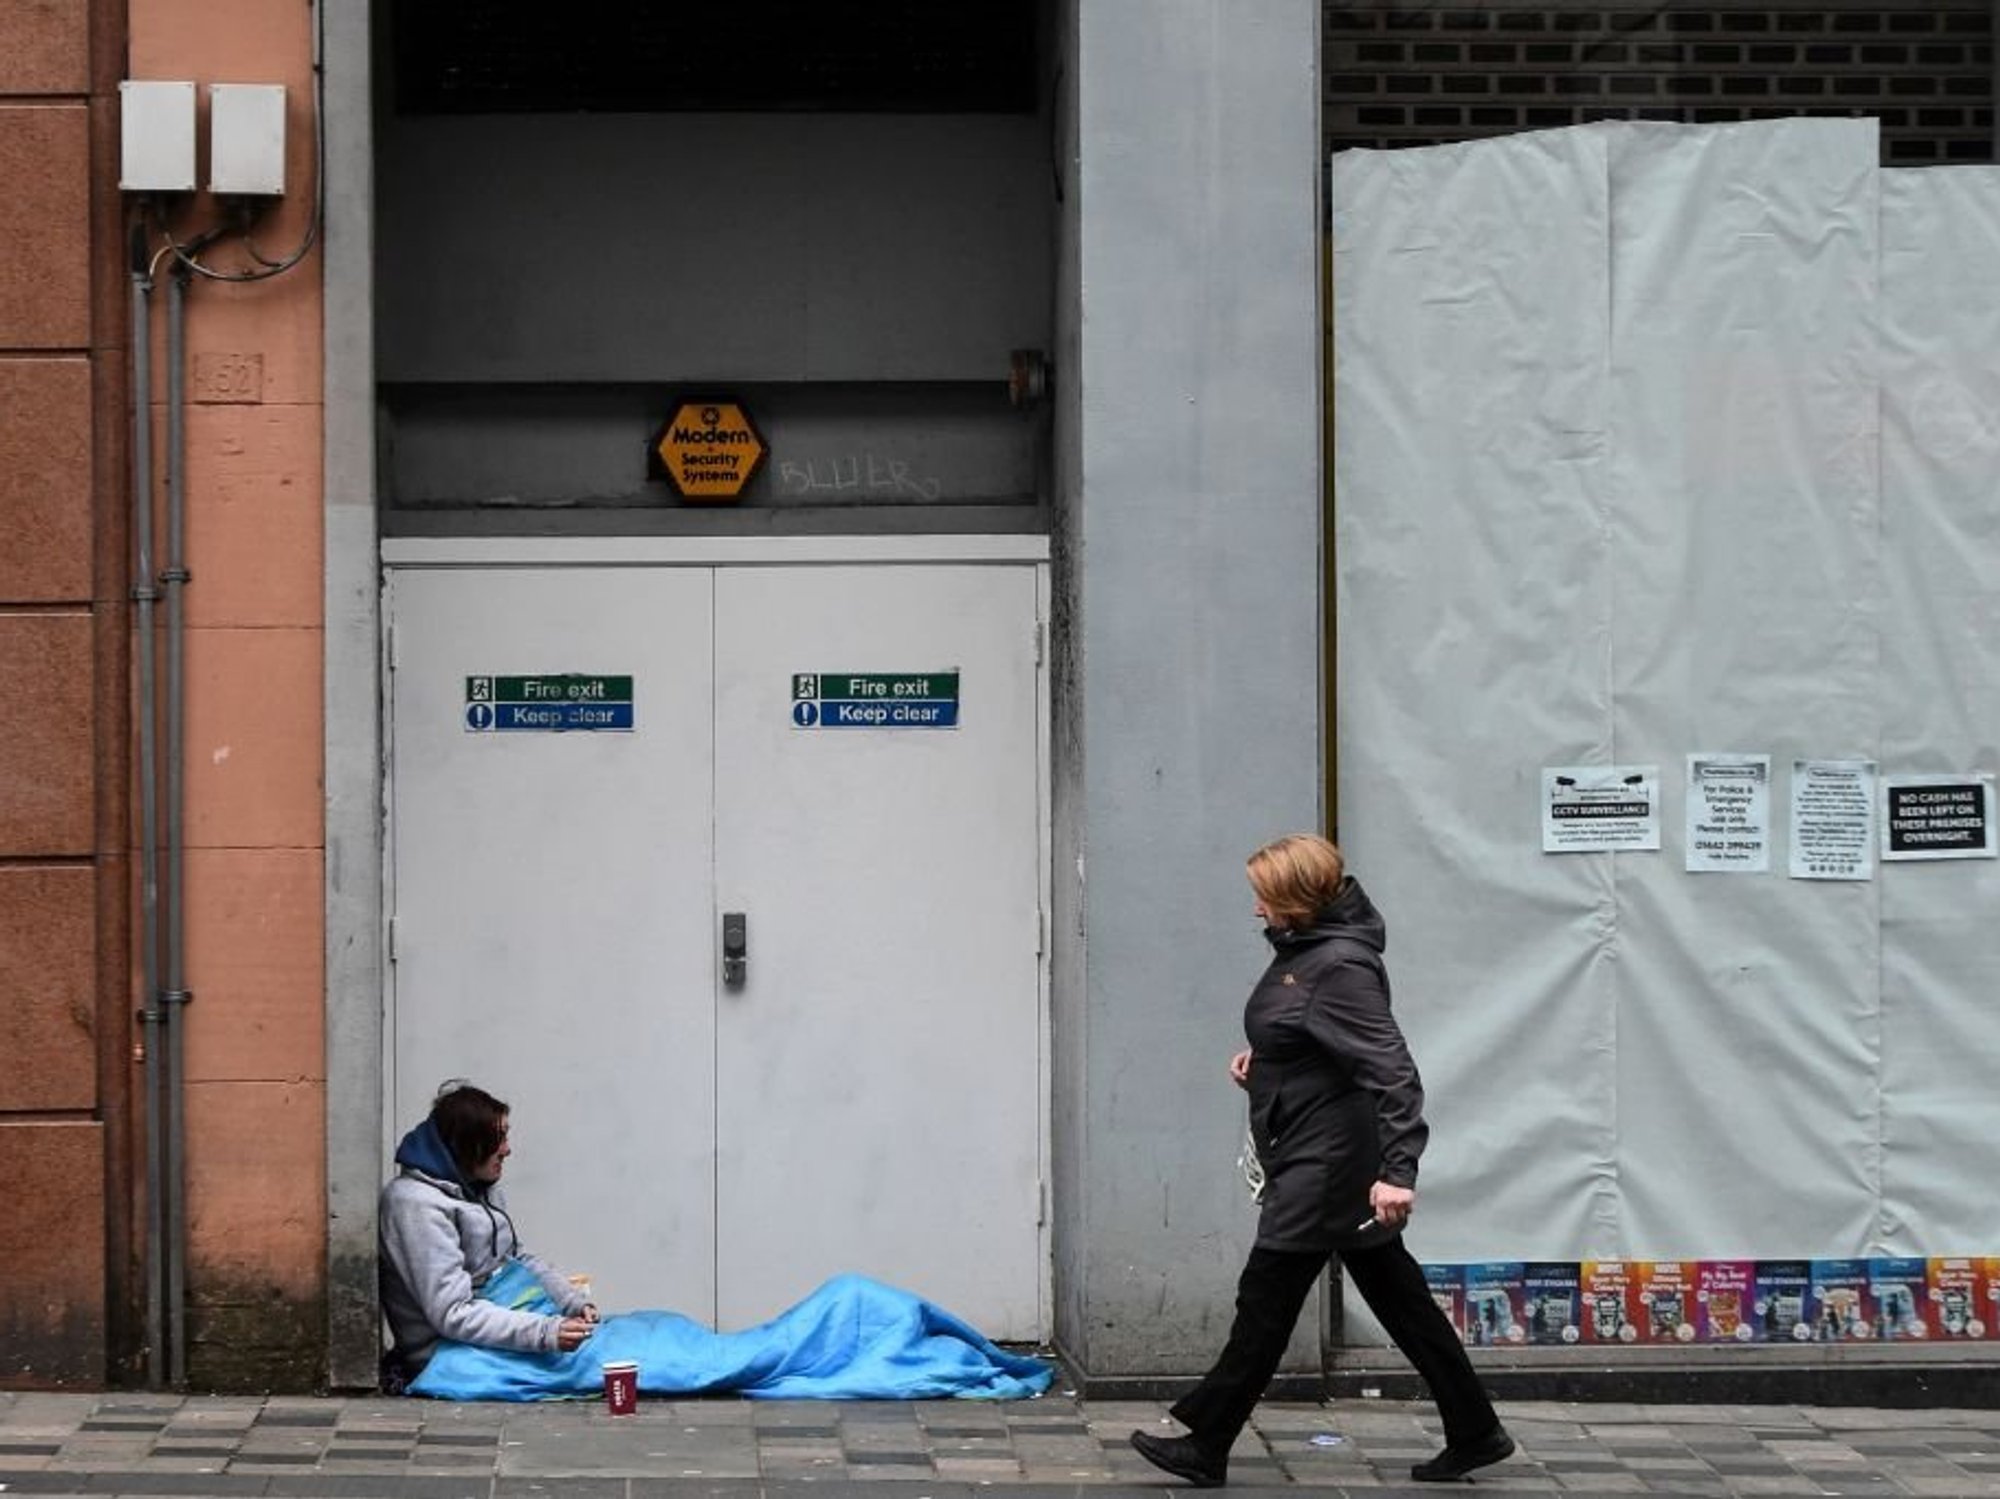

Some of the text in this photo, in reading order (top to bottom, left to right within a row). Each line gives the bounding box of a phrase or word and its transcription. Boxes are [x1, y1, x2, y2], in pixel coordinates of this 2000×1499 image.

[673, 427, 750, 444] Modern
[681, 452, 740, 468] Security
[683, 468, 740, 484] Systems
[524, 681, 605, 698] Fire exit
[849, 679, 929, 695] Fire exit
[513, 706, 615, 726] Keep clear
[838, 705, 939, 724] Keep clear
[1899, 791, 1974, 804] NO CASH HAS
[1553, 804, 1646, 816] CCTV SURVEILLANCE
[1899, 804, 1975, 817] BEEN LEFT ON
[1893, 819, 1927, 830] THESE
